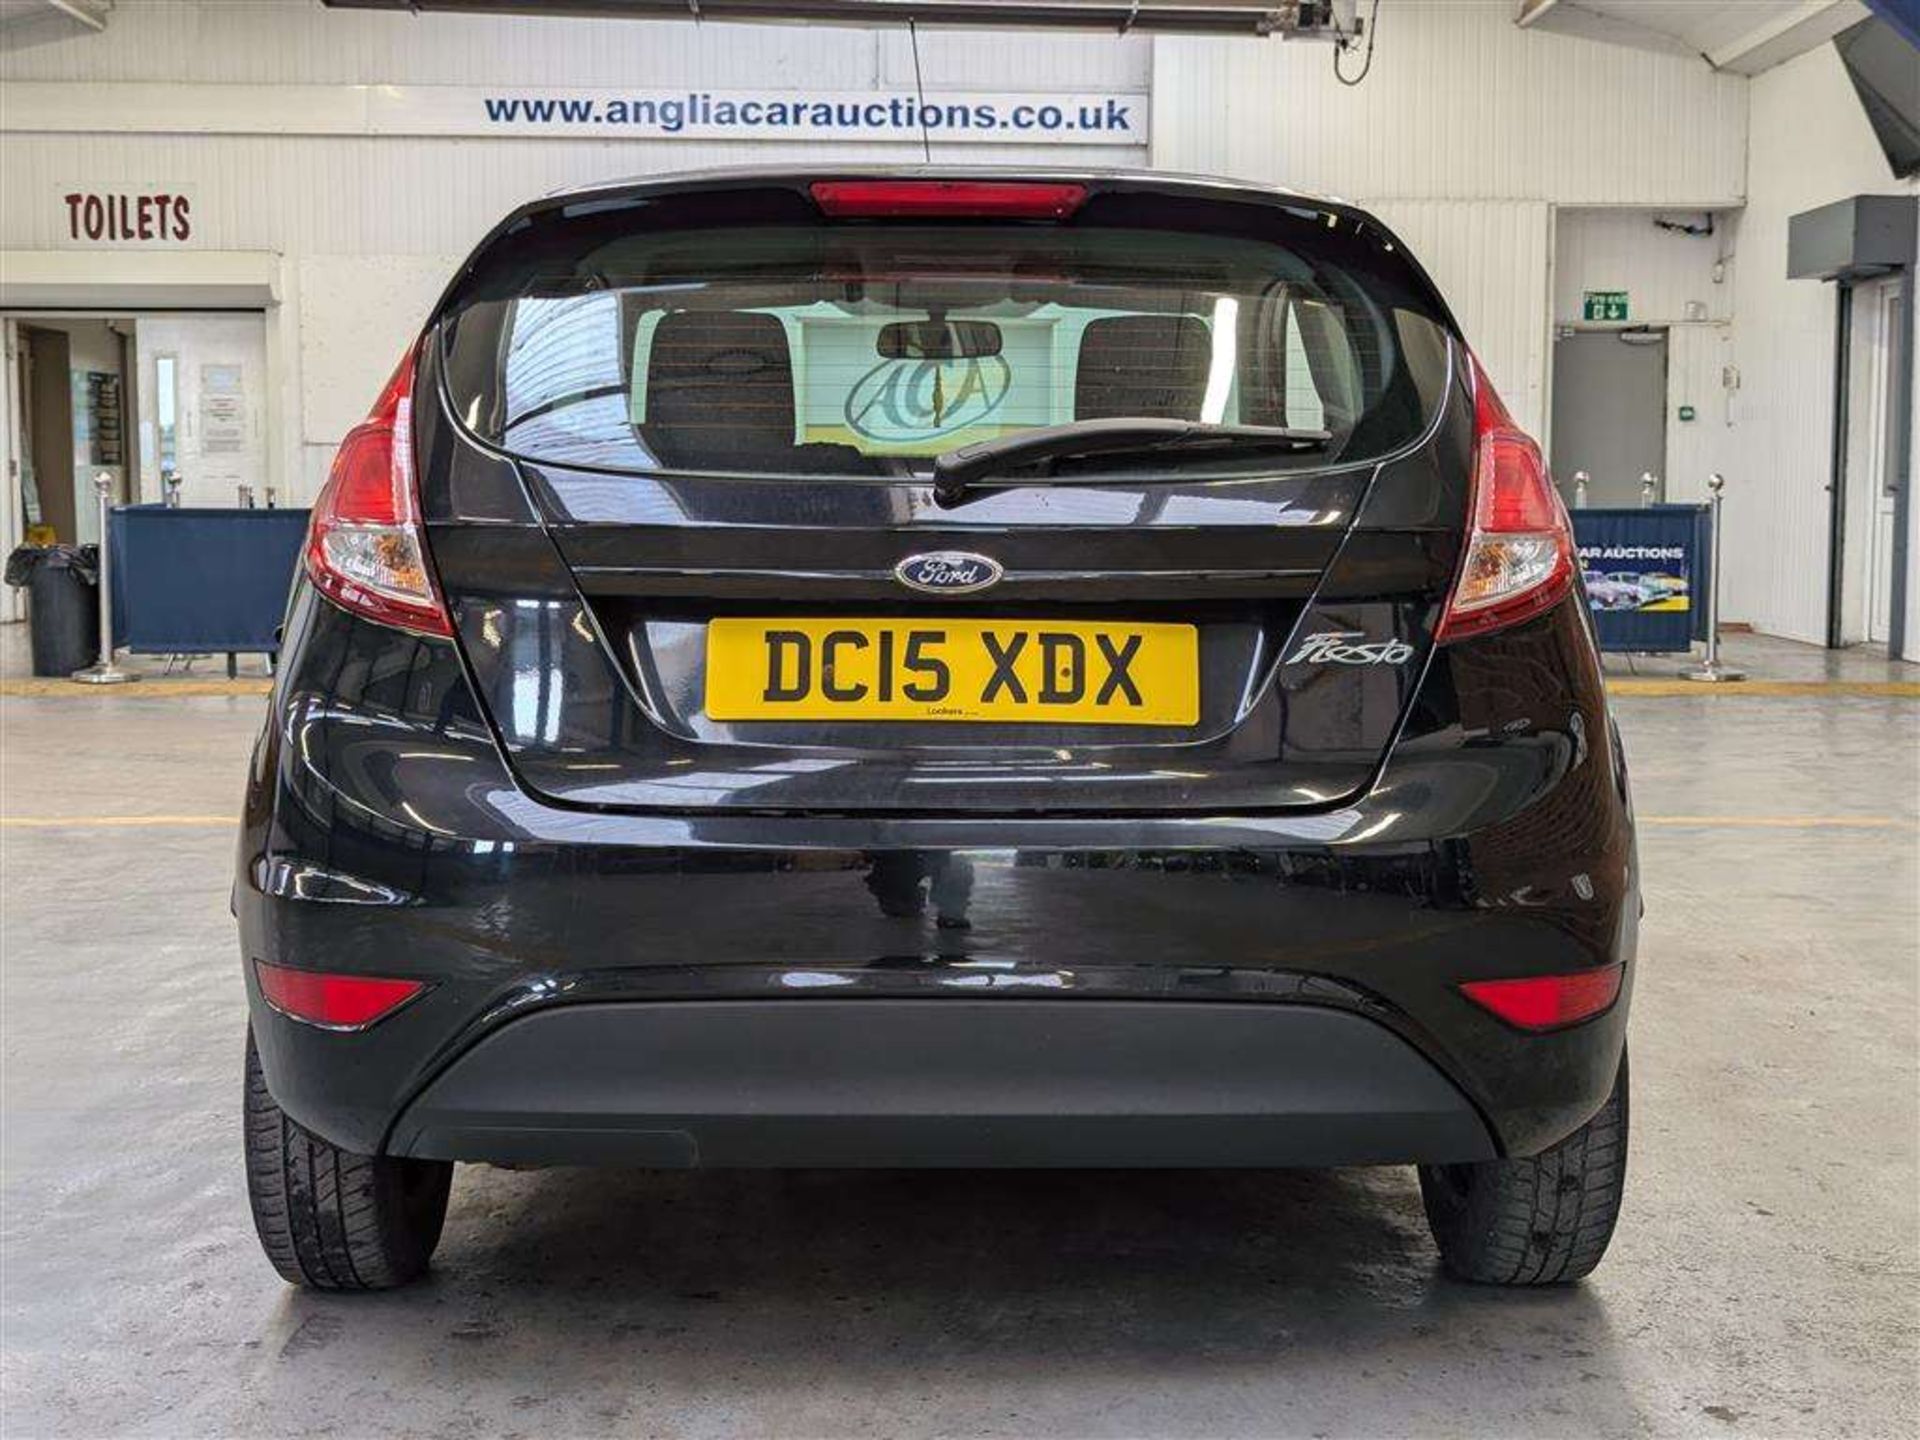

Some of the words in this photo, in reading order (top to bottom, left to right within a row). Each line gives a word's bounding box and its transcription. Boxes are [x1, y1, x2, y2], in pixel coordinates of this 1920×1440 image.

[484, 93, 1130, 132] www.angliacarauctions.co.uk
[64, 193, 190, 240] TOILETS
[1577, 547, 1602, 558] AR
[1603, 547, 1684, 559] AUCTIONS
[918, 560, 979, 585] Ford
[1285, 631, 1414, 665] Fiesta
[763, 629, 951, 703] DC15
[980, 631, 1144, 707] XDX
